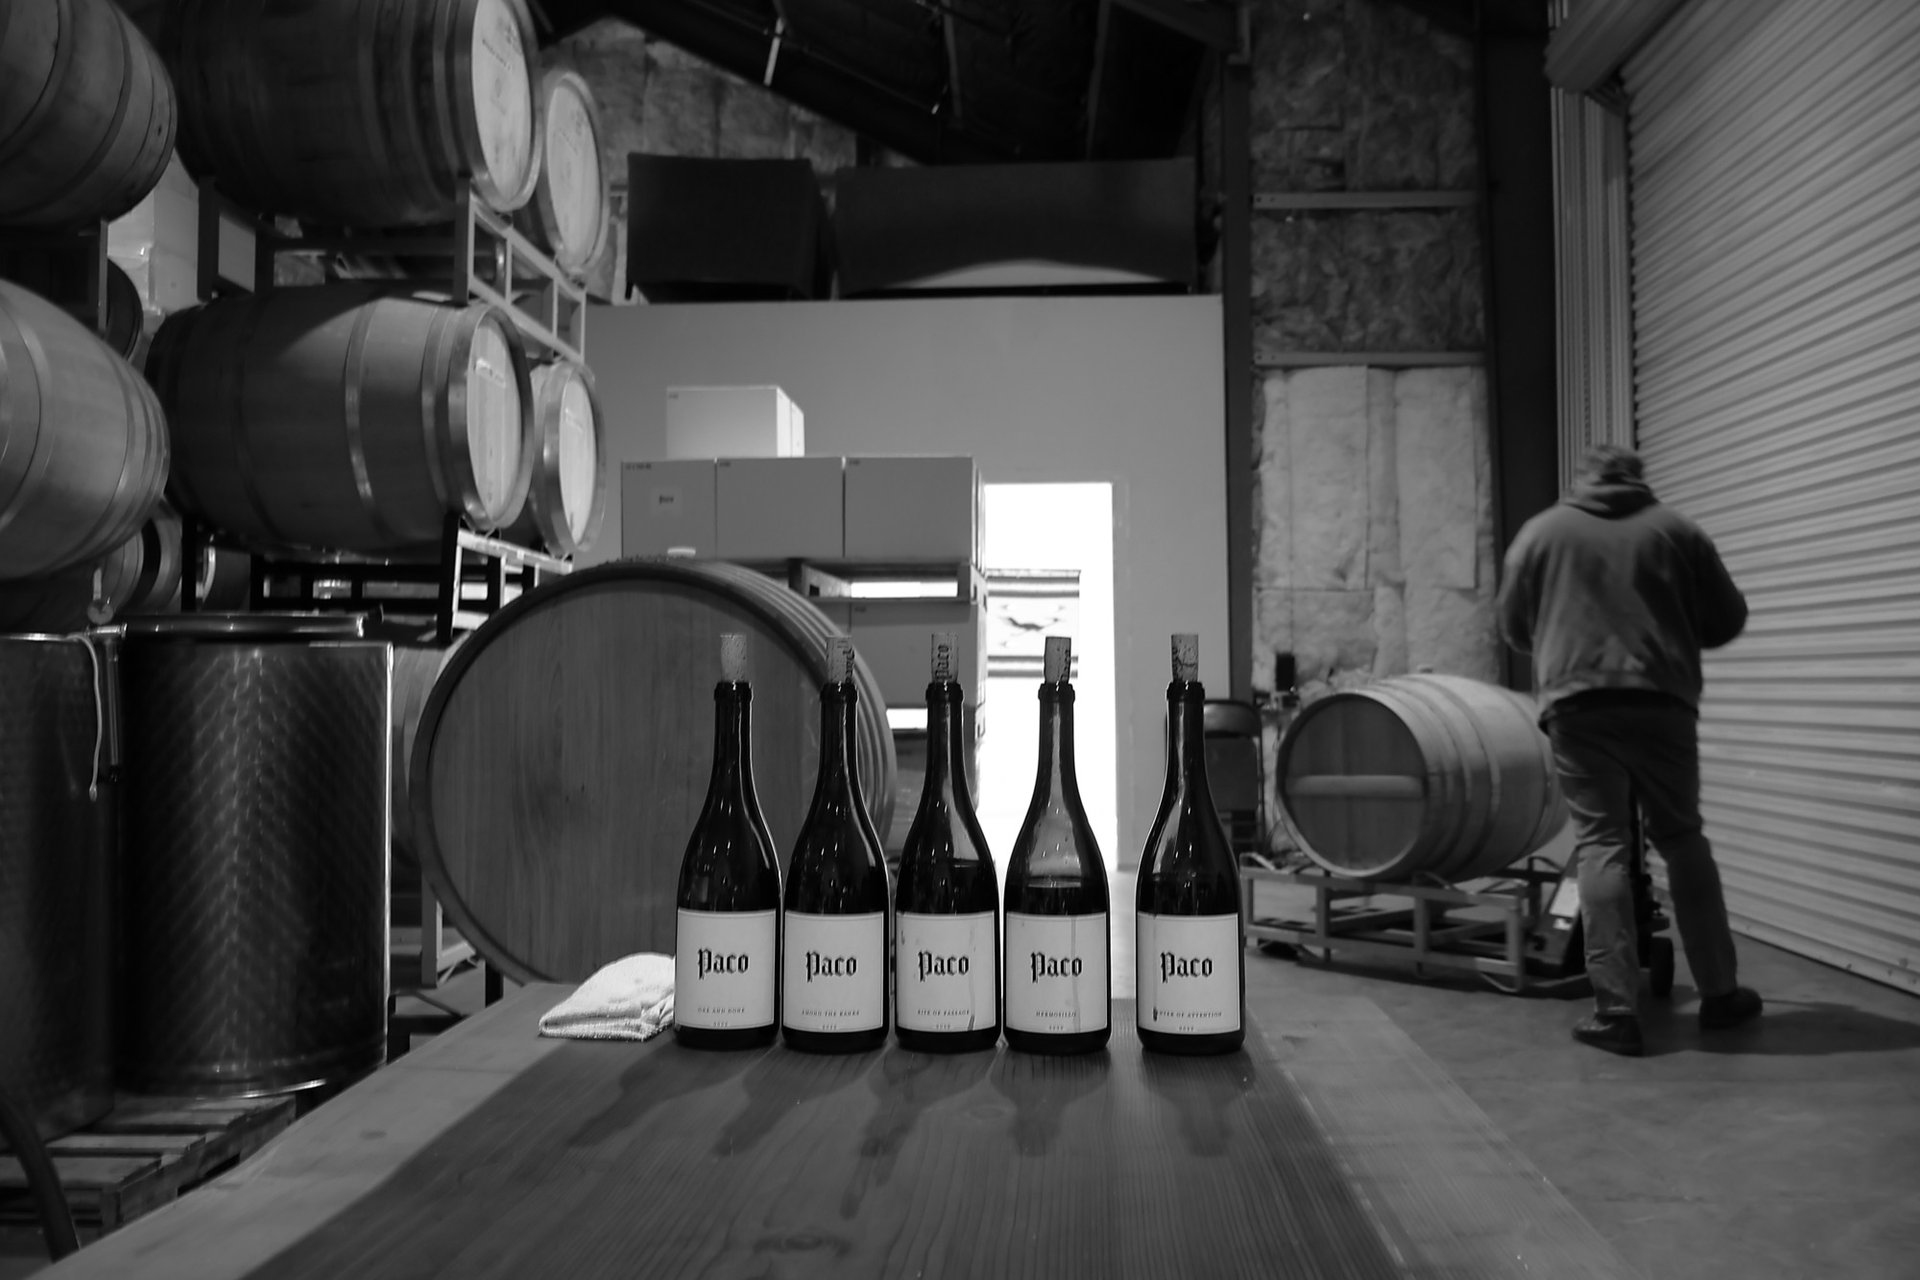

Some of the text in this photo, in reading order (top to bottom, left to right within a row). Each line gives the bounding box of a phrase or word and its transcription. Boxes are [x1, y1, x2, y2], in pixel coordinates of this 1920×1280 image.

[934, 644, 953, 680] Paco
[697, 948, 749, 980] Paco
[805, 951, 857, 983] Paco
[918, 951, 970, 983] Paco
[1030, 951, 1082, 984] Paco
[1160, 951, 1213, 984] Paco
